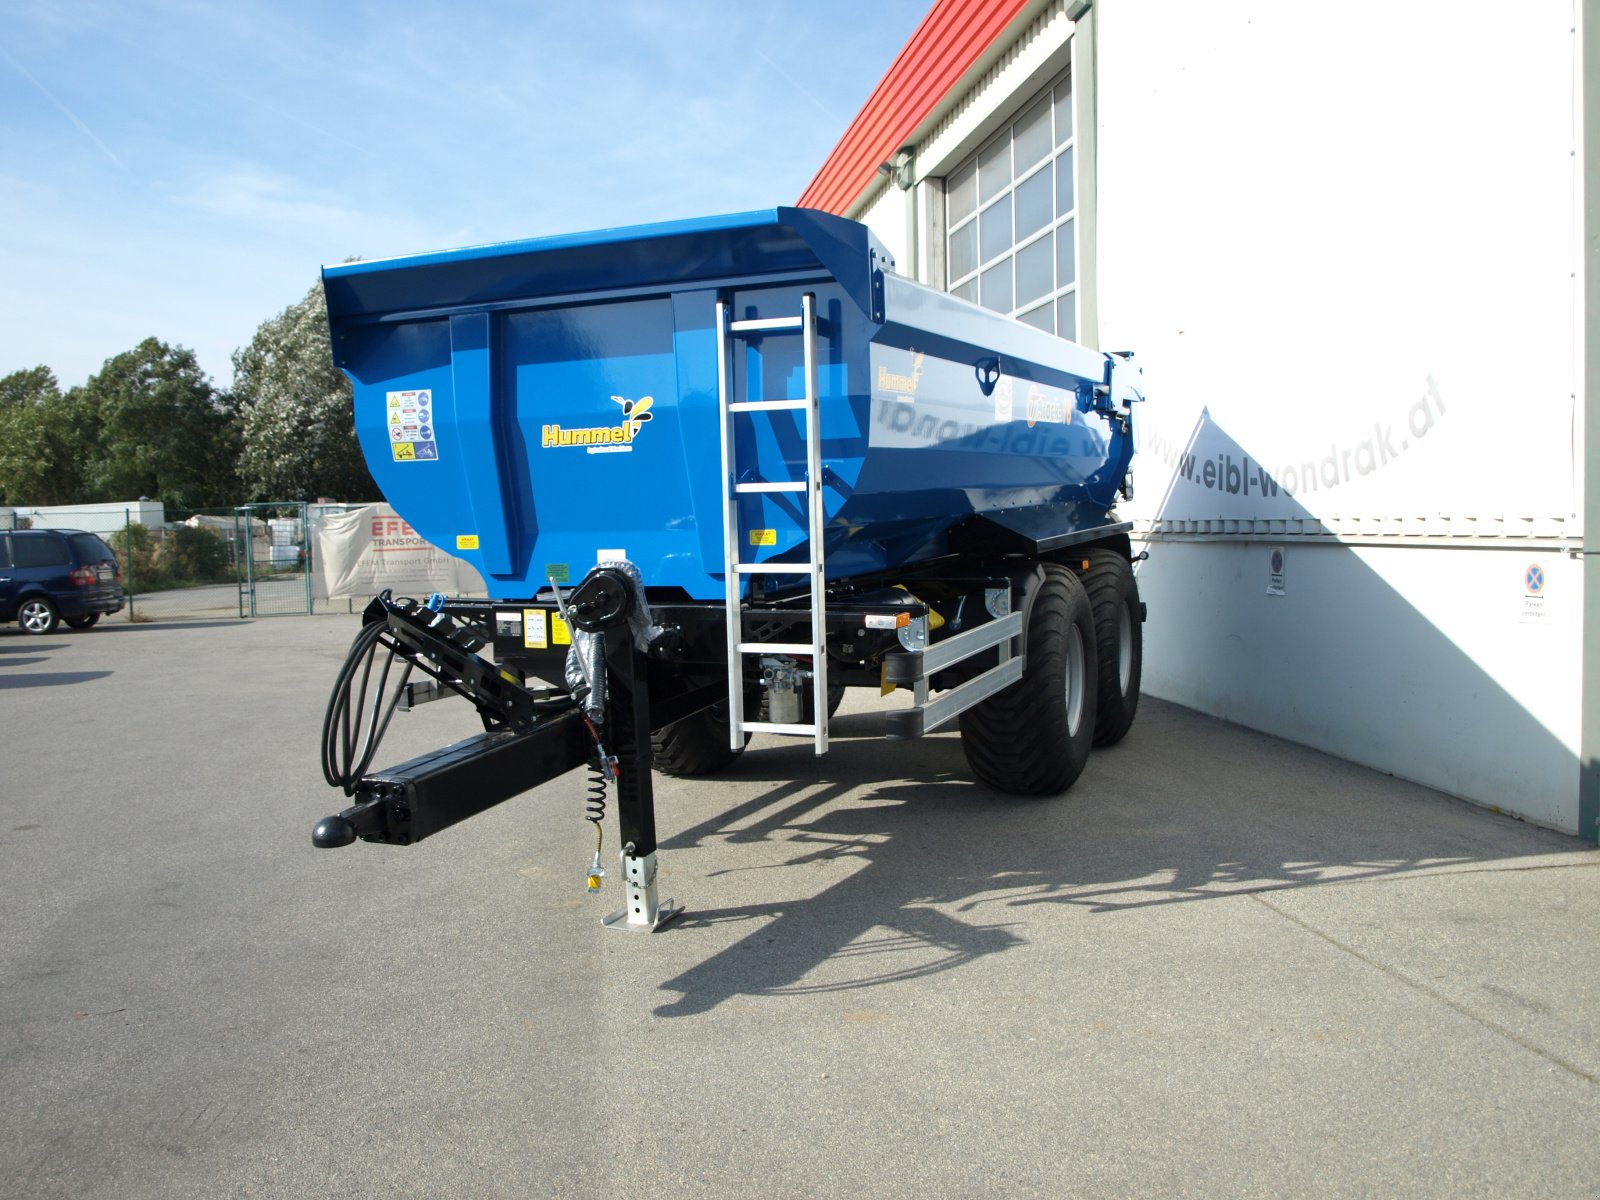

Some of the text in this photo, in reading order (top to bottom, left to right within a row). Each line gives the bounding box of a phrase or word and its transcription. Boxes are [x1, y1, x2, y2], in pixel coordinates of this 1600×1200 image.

[542, 421, 632, 447] Hummel
[1147, 373, 1447, 498] www.eibl-wondrak.at
[371, 521, 414, 537] EFE
[372, 537, 427, 547] TRANSPOR
